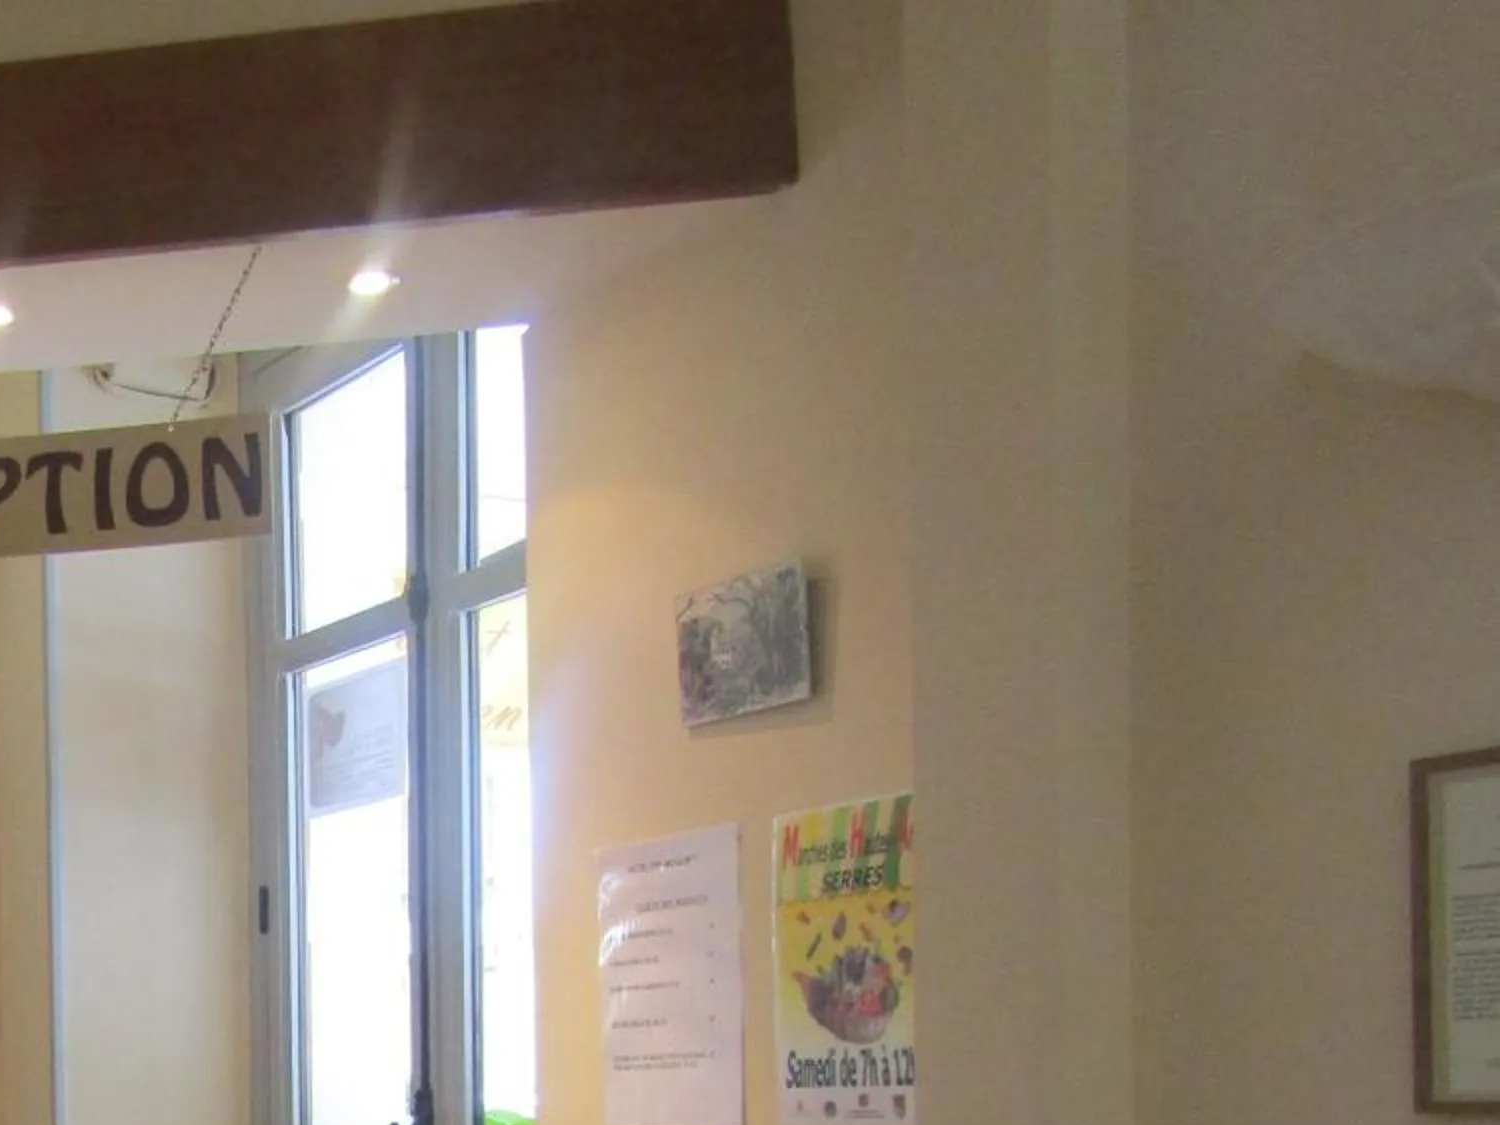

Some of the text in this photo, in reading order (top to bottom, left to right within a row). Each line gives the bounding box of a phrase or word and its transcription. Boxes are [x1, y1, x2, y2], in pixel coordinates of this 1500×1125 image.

[785, 1048, 836, 1089] Samedi
[840, 1047, 858, 1088] de
[859, 1047, 879, 1087] 7h
